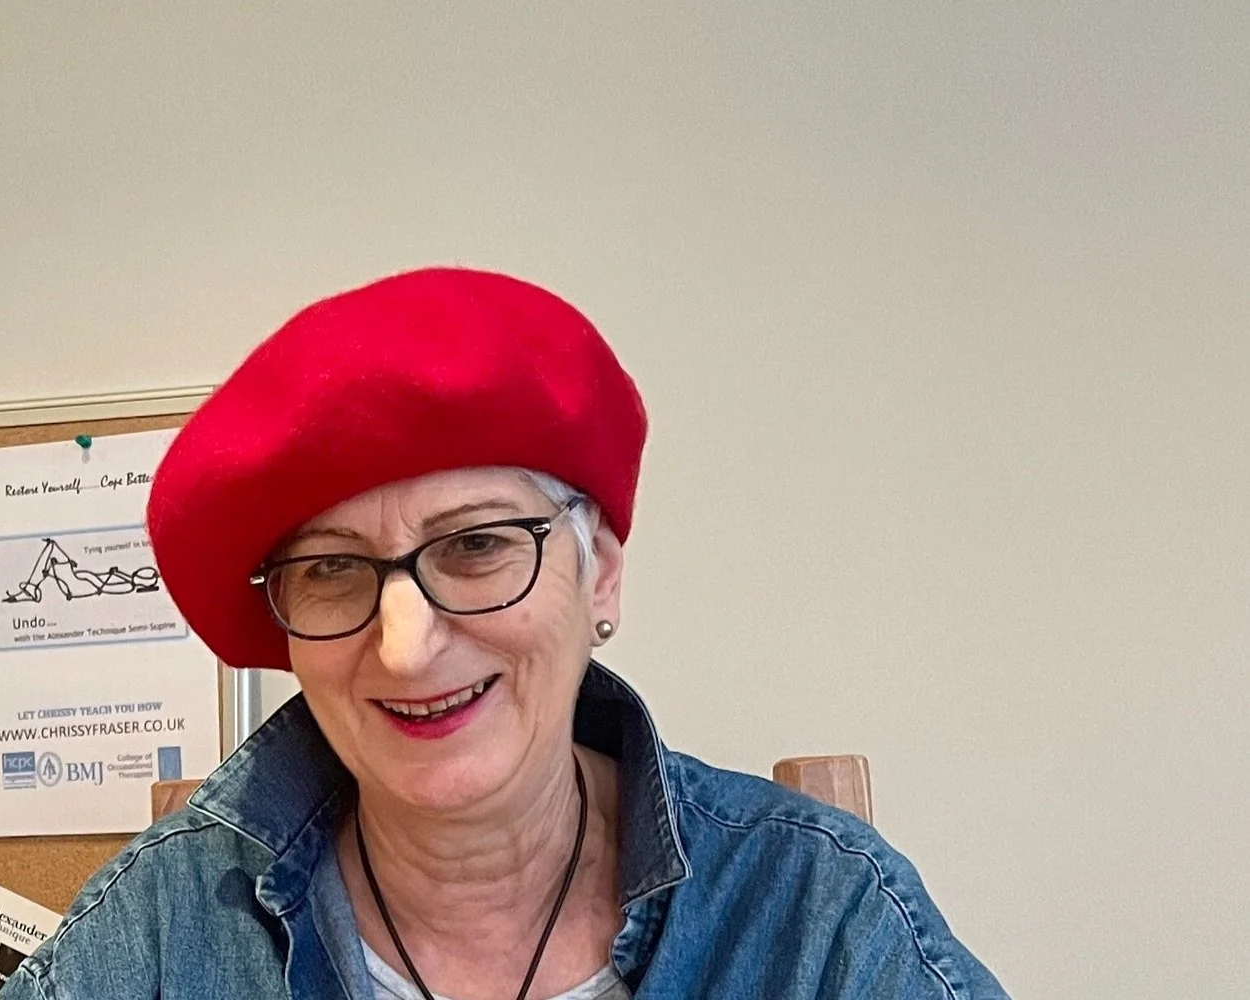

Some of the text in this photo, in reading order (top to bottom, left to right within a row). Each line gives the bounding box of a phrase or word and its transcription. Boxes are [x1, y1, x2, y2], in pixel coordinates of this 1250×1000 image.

[4, 484, 39, 497] Restore
[17, 710, 36, 720] LET
[79, 704, 112, 716] TEACH
[114, 703, 135, 713] YOU
[66, 761, 104, 785] BMJ
